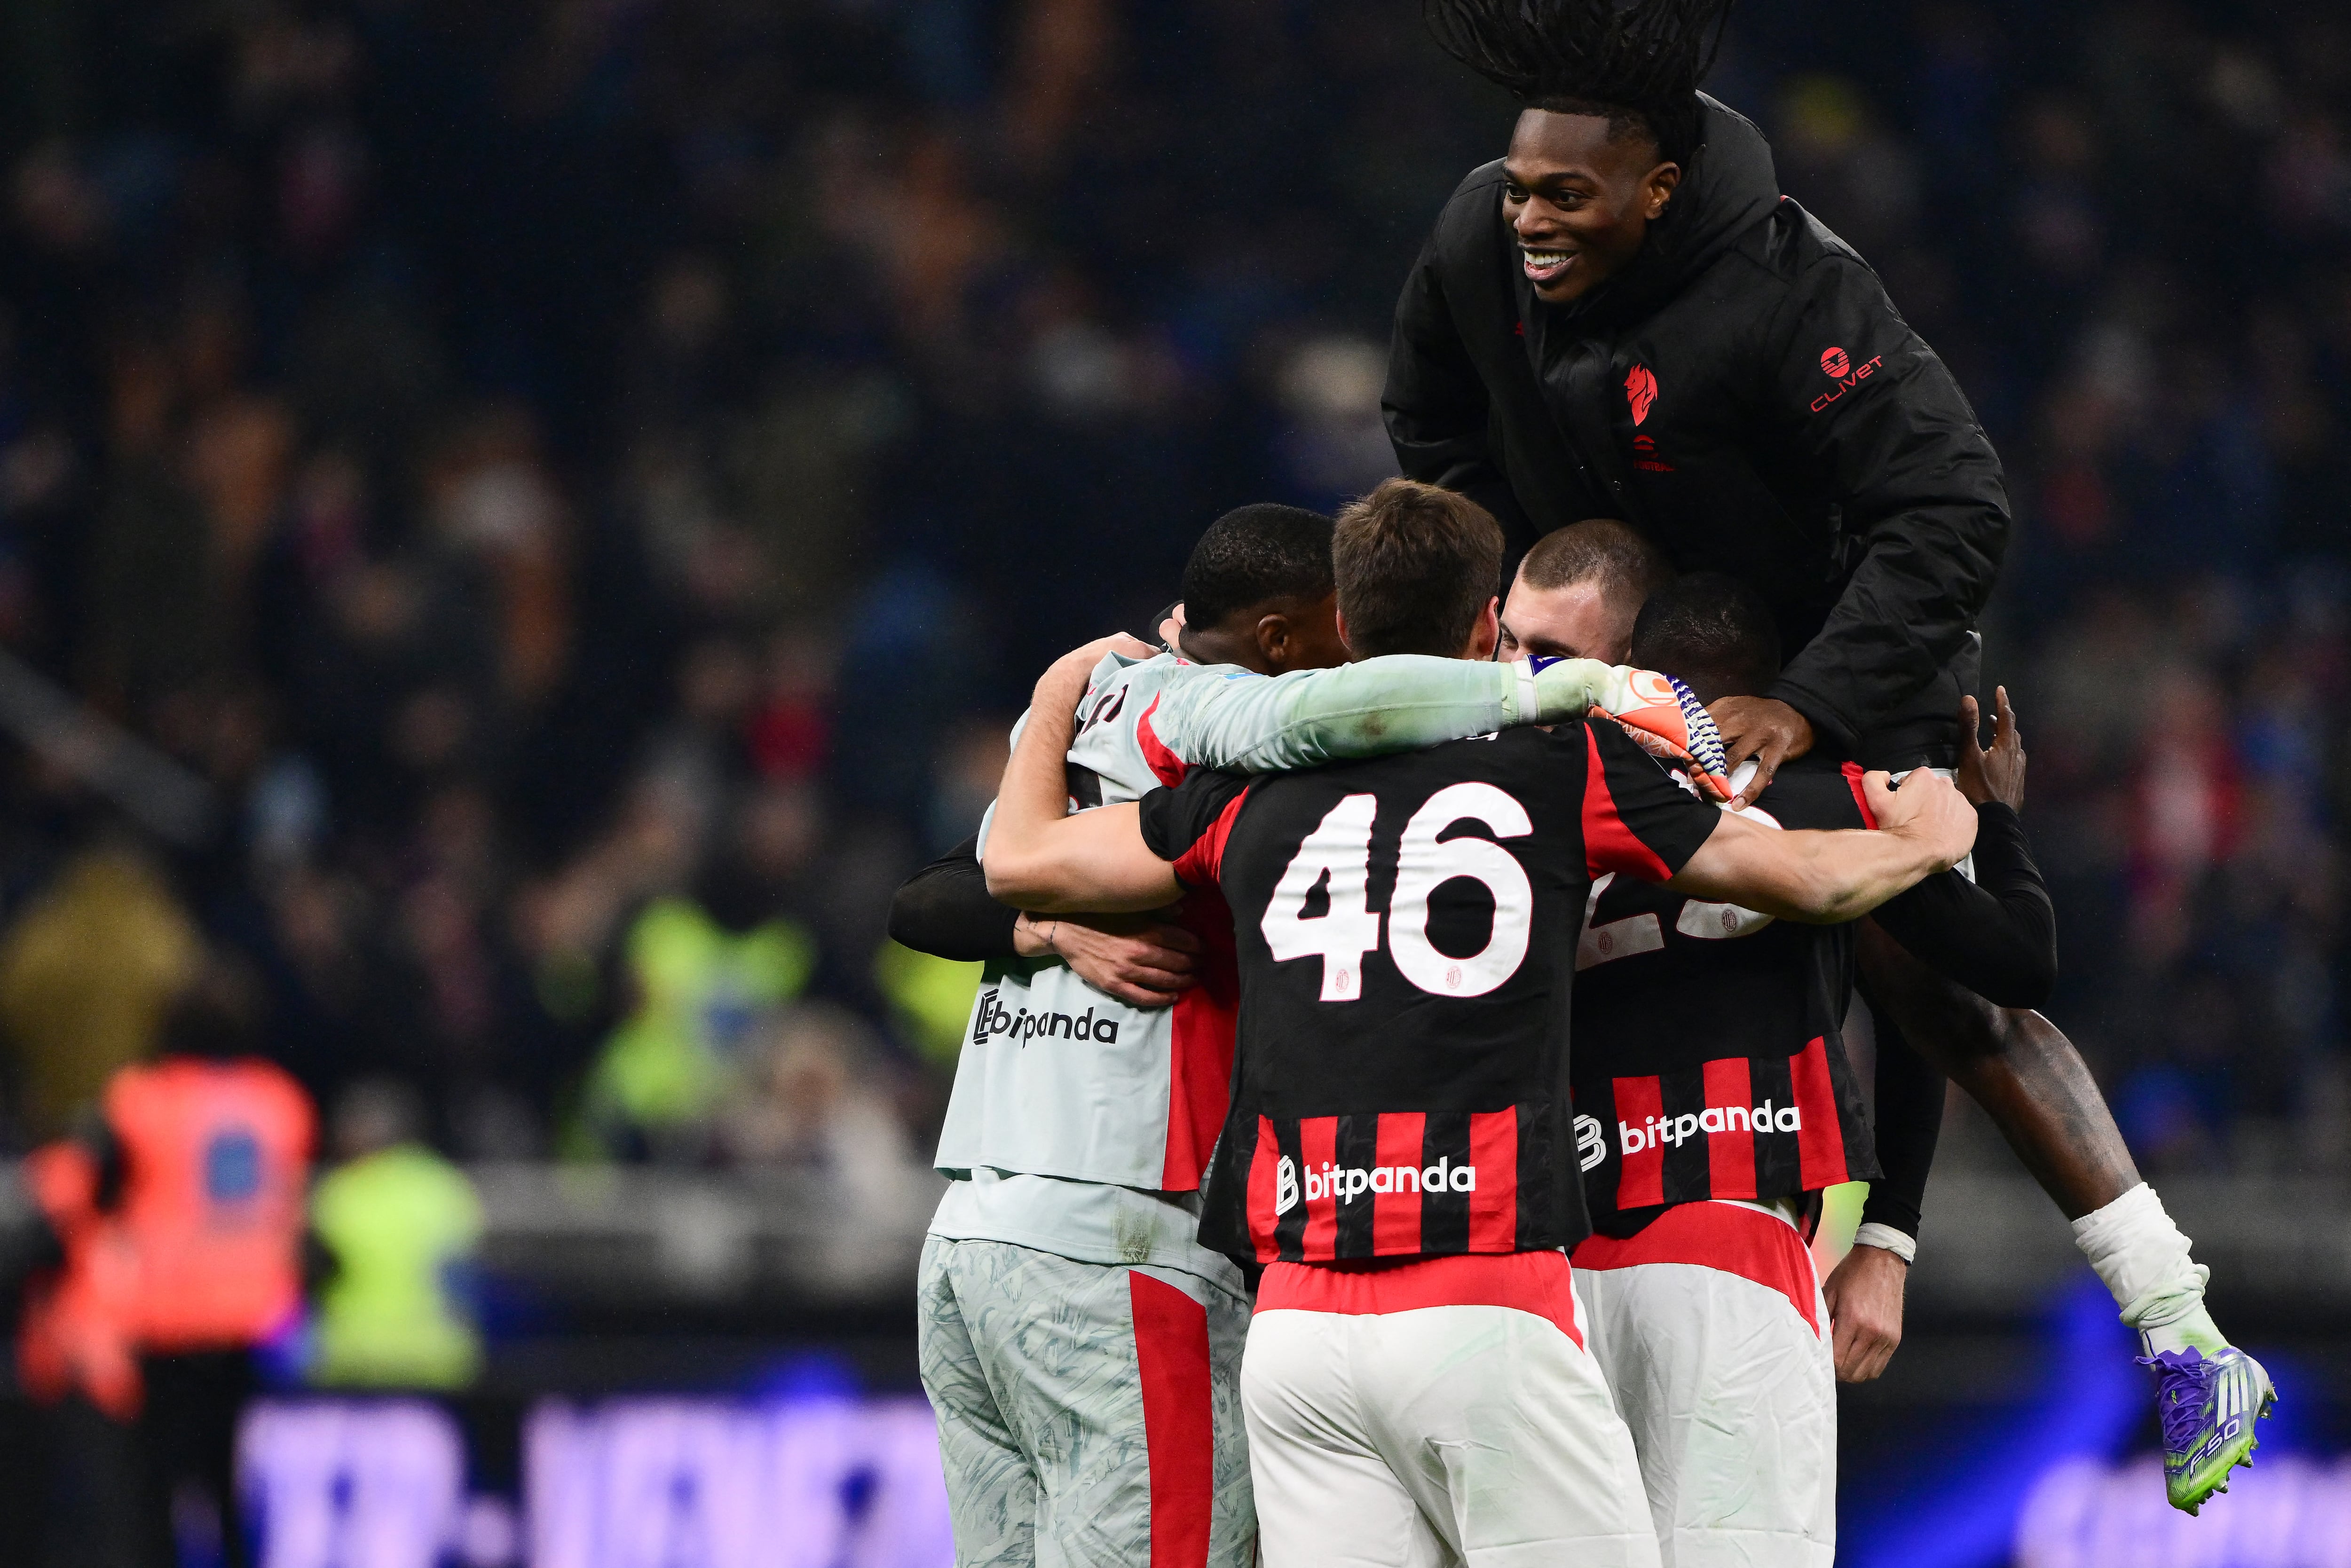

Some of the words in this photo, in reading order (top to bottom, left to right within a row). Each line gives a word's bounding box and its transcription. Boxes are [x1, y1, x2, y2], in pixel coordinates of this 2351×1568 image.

[1810, 355, 1882, 412] CLIVET
[1260, 781, 1533, 1001] 46
[990, 1001, 1119, 1049] bipanda
[1619, 1099, 1801, 1155] bitpanda
[1305, 1156, 1476, 1205] bitpanda
[2190, 1418, 2240, 1475] F50
